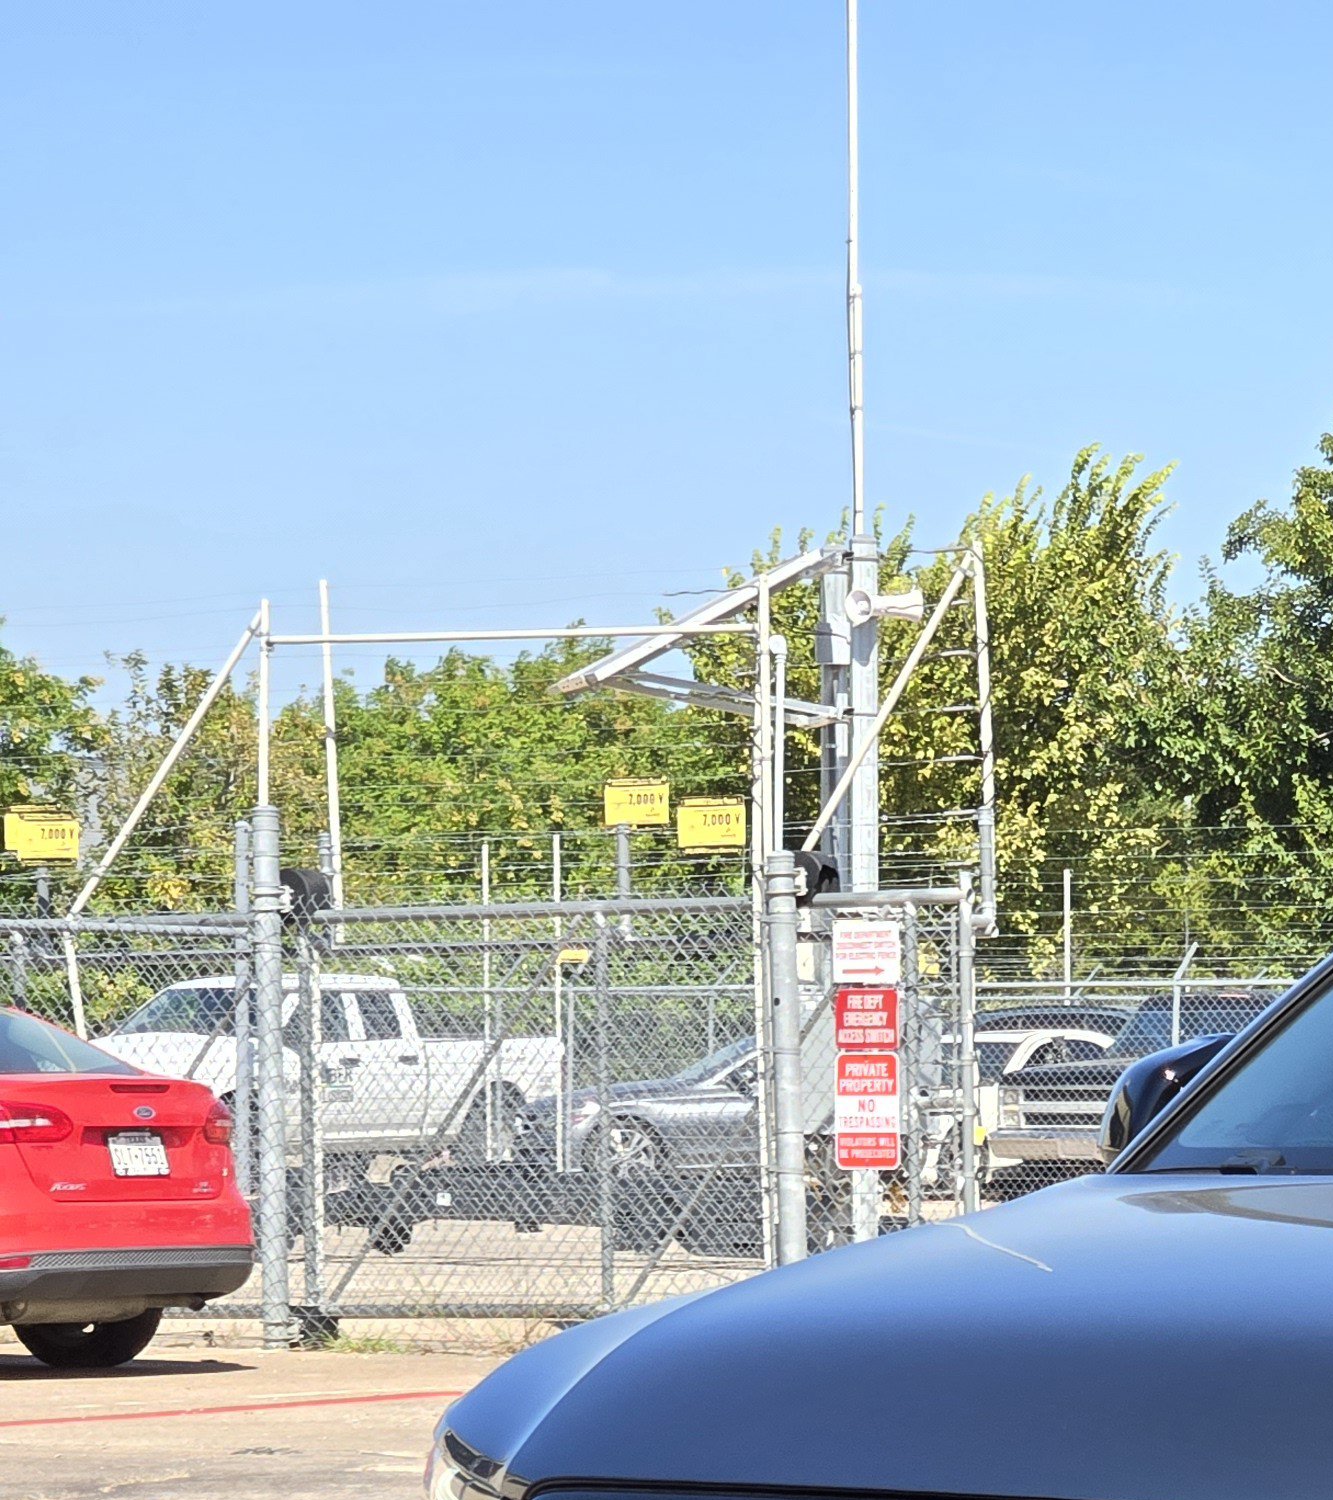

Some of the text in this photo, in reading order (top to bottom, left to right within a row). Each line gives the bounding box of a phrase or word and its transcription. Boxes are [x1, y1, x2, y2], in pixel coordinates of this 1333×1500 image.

[844, 1063, 889, 1078] PRIVATE
[839, 1078, 895, 1093] PROPERTY
[858, 1098, 875, 1113] NO
[838, 1116, 896, 1128] TRESPASSING
